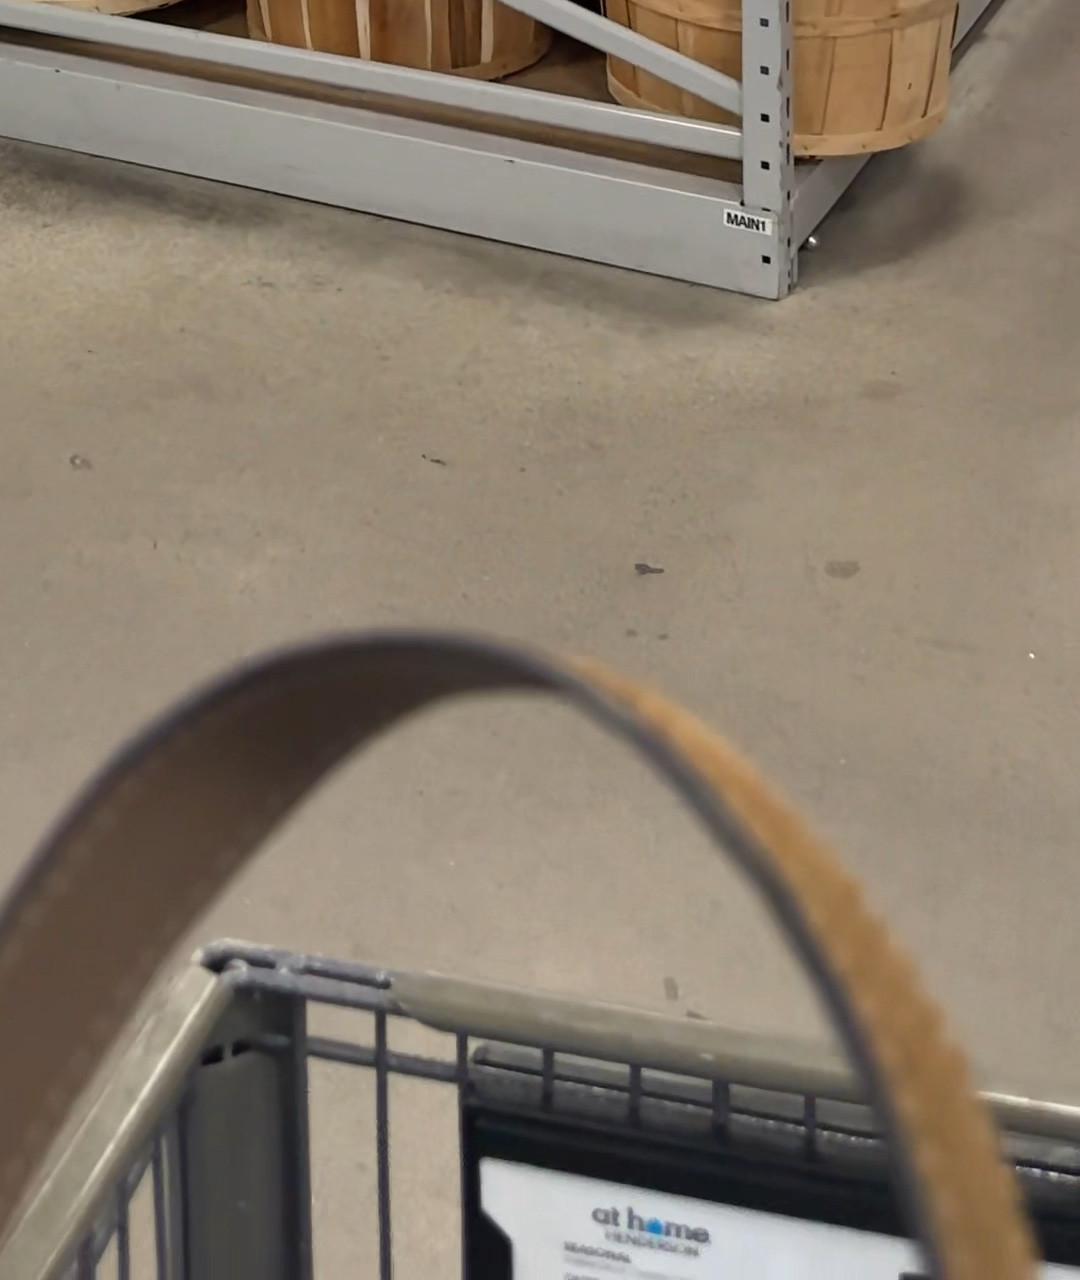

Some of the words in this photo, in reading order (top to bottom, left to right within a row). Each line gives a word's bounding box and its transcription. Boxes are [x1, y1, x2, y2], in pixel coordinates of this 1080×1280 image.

[726, 211, 766, 232] MAIN1
[592, 1207, 620, 1228] at
[627, 1206, 710, 1243] home
